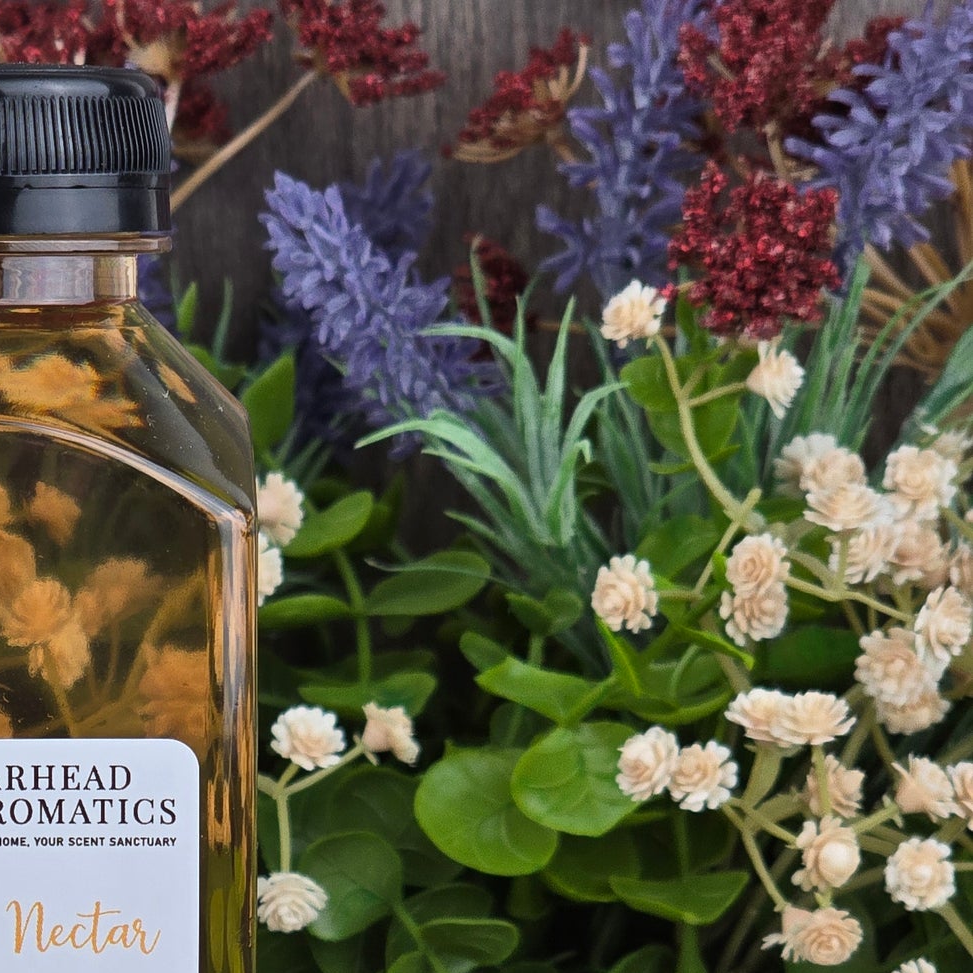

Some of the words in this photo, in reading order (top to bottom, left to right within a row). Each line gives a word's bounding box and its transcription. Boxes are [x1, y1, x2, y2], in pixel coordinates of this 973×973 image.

[33, 836, 64, 847] YOUR
[68, 836, 106, 847] SCENT
[108, 836, 177, 847] SANCTUARY
[6, 900, 161, 955] Nectar
